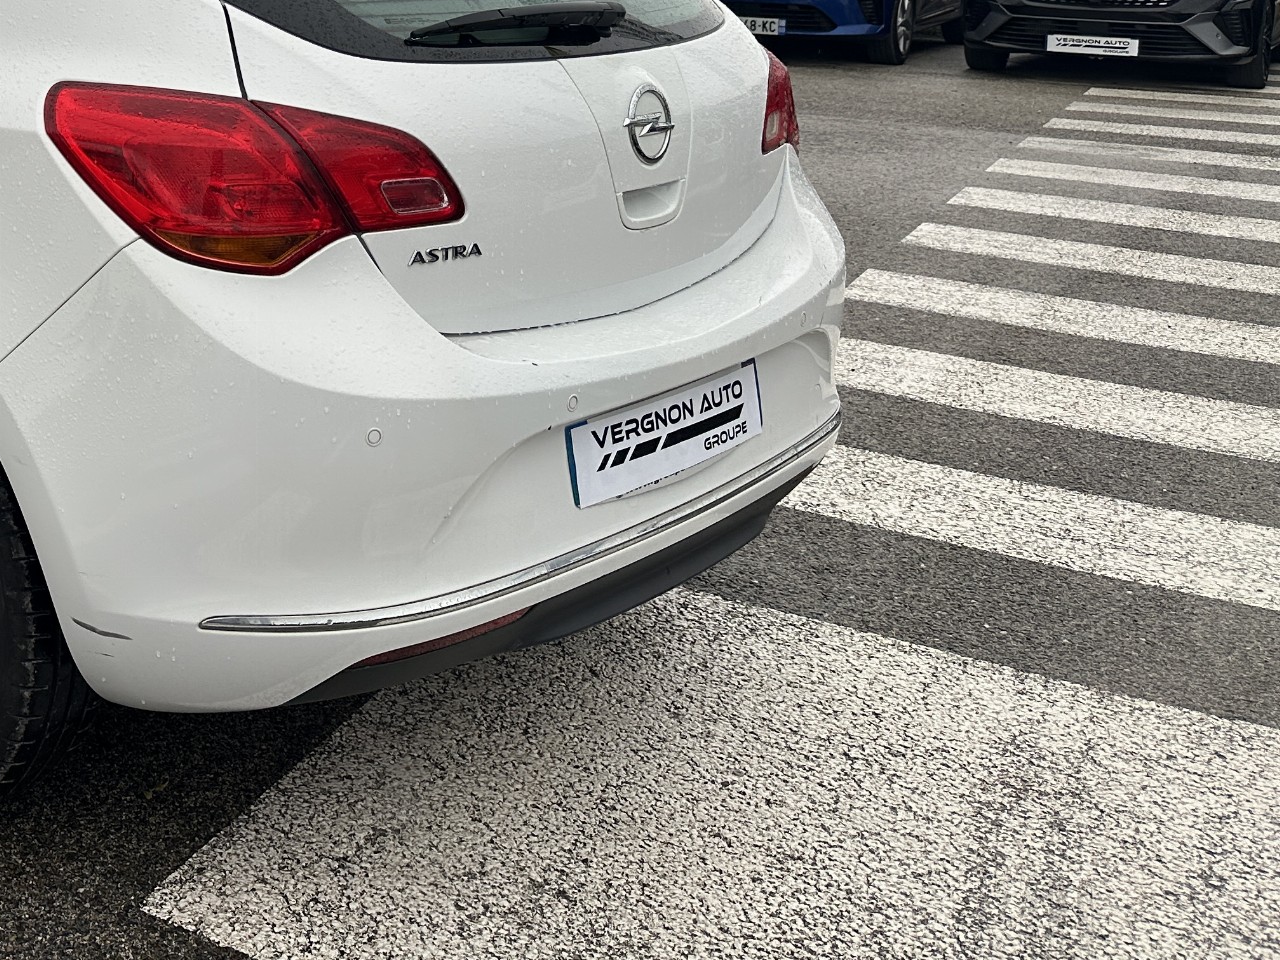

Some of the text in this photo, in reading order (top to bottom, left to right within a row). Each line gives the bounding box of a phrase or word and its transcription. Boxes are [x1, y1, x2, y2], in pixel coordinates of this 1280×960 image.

[743, 19, 776, 33] 8-KC
[1055, 36, 1101, 45] VERGNON
[408, 242, 482, 266] ASTRA
[591, 380, 743, 448] VERGNON AUTO
[704, 420, 749, 451] GROUPE
